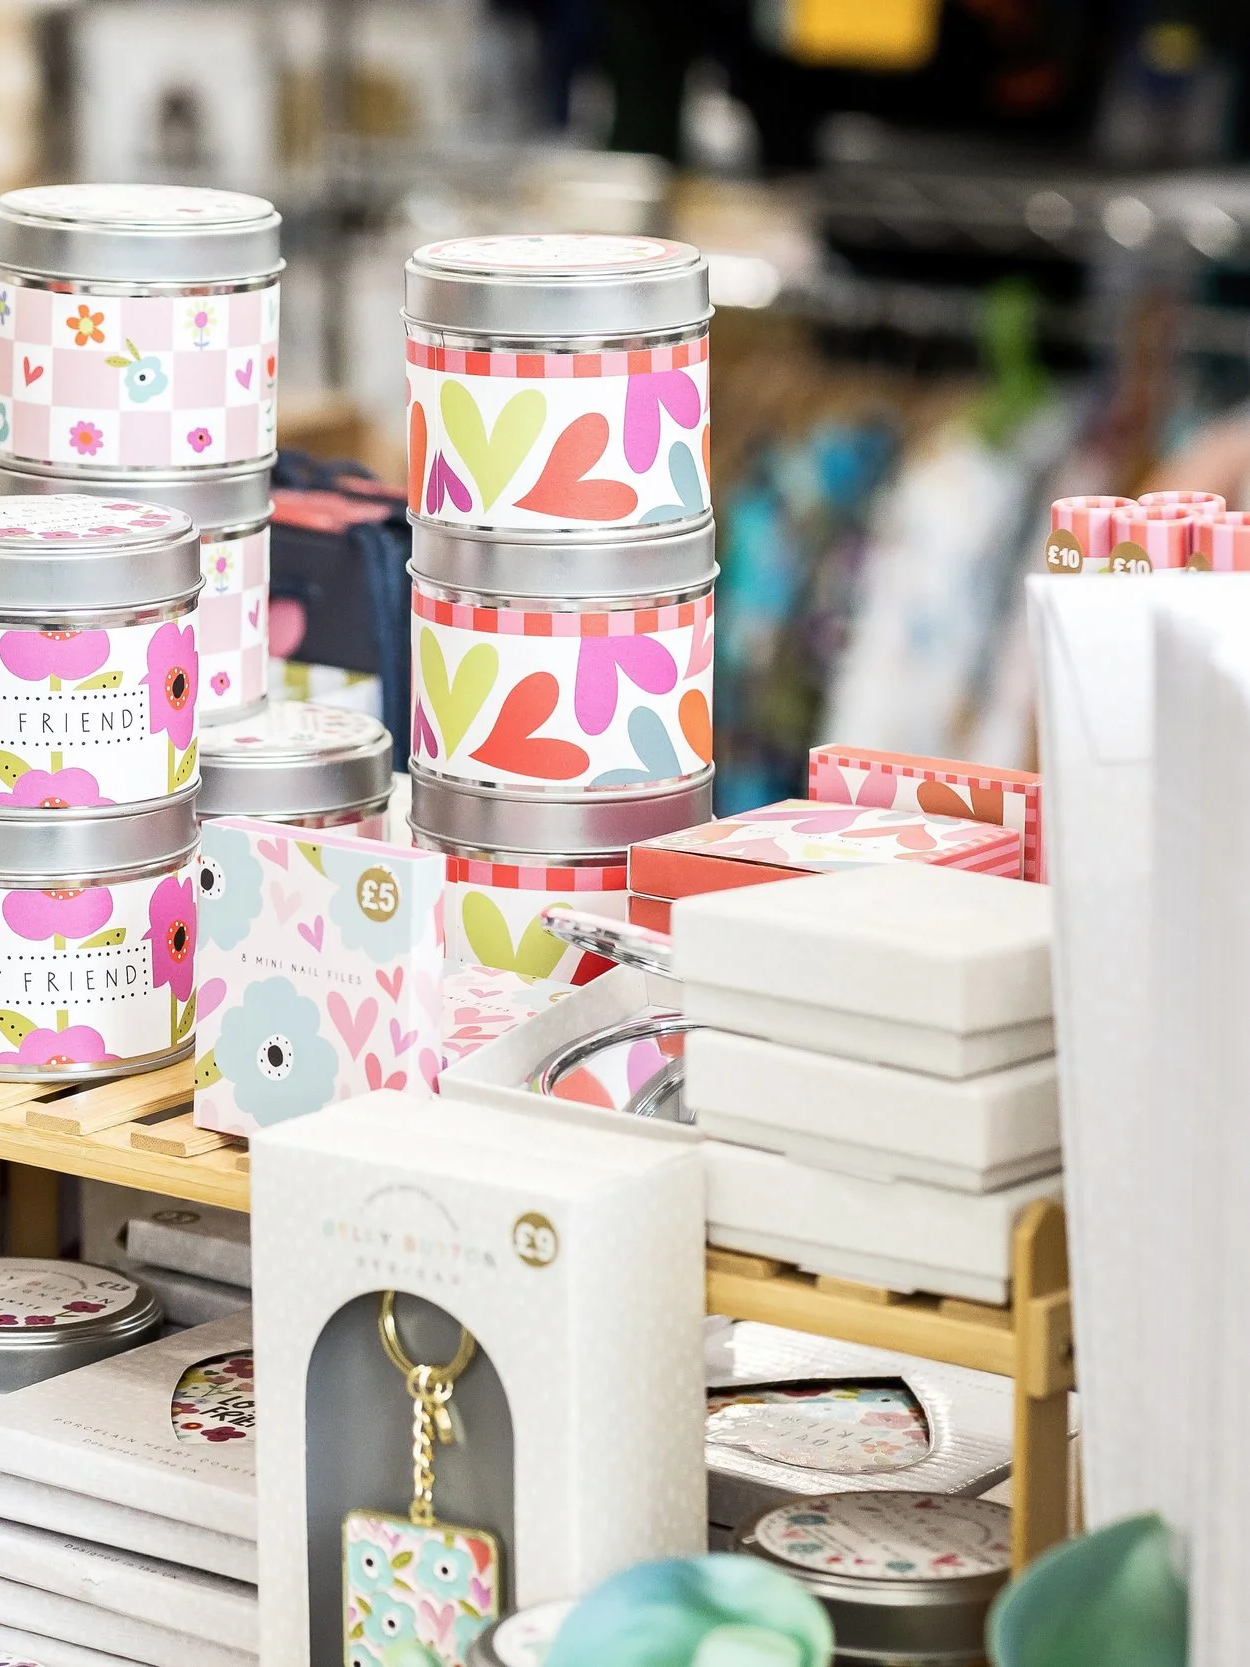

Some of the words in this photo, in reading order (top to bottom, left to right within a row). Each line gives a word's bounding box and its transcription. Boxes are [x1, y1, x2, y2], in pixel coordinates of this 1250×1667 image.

[1048, 545, 1080, 569] £10
[1113, 557, 1150, 574] £10
[19, 709, 134, 733] FRIEND
[360, 879, 395, 912] £5
[24, 964, 137, 992] FRIEND
[241, 953, 247, 964] 8
[255, 956, 284, 970] MINI
[291, 964, 319, 977] NAIL
[327, 970, 363, 986] FILES
[217, 1395, 255, 1409] LO
[53, 1417, 137, 1444] PORCELAIN
[144, 1442, 193, 1458] HEART
[82, 1438, 139, 1457] Designed
[158, 1459, 178, 1468] the
[64, 1543, 120, 1563] Designed
[139, 1565, 158, 1574] the
